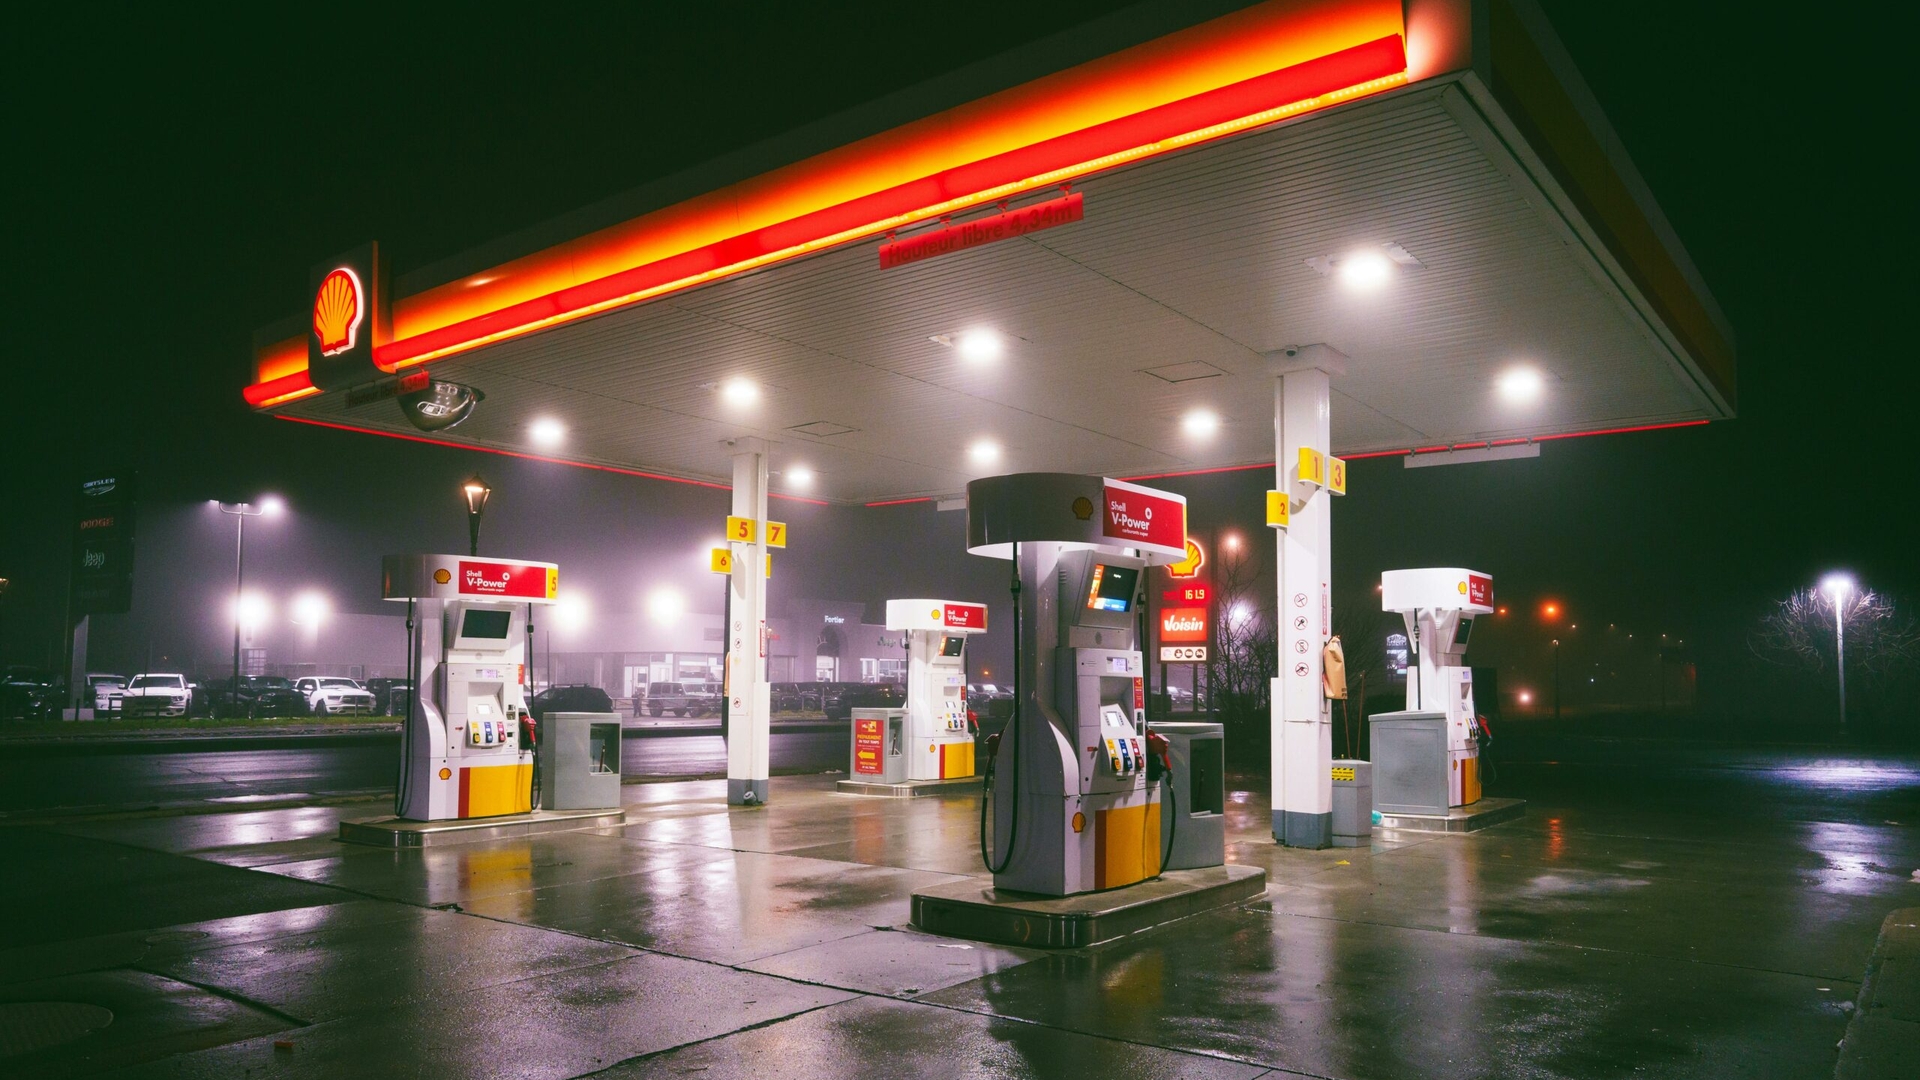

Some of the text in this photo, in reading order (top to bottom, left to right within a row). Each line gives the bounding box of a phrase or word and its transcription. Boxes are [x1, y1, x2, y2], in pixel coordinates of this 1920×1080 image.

[888, 206, 1072, 265] Hauteur libre 4,34m
[1335, 464, 1342, 487] 3
[1111, 501, 1126, 512] Shell
[1280, 502, 1286, 515] 2
[1111, 511, 1150, 530] V-Power
[739, 522, 748, 538] 5
[771, 526, 780, 542] 7
[83, 549, 105, 569] Jeep
[720, 557, 727, 566] 6
[466, 570, 482, 578] Shell
[467, 577, 507, 588] V-Power
[551, 577, 557, 592] 5
[1164, 615, 1204, 631] Voisin
